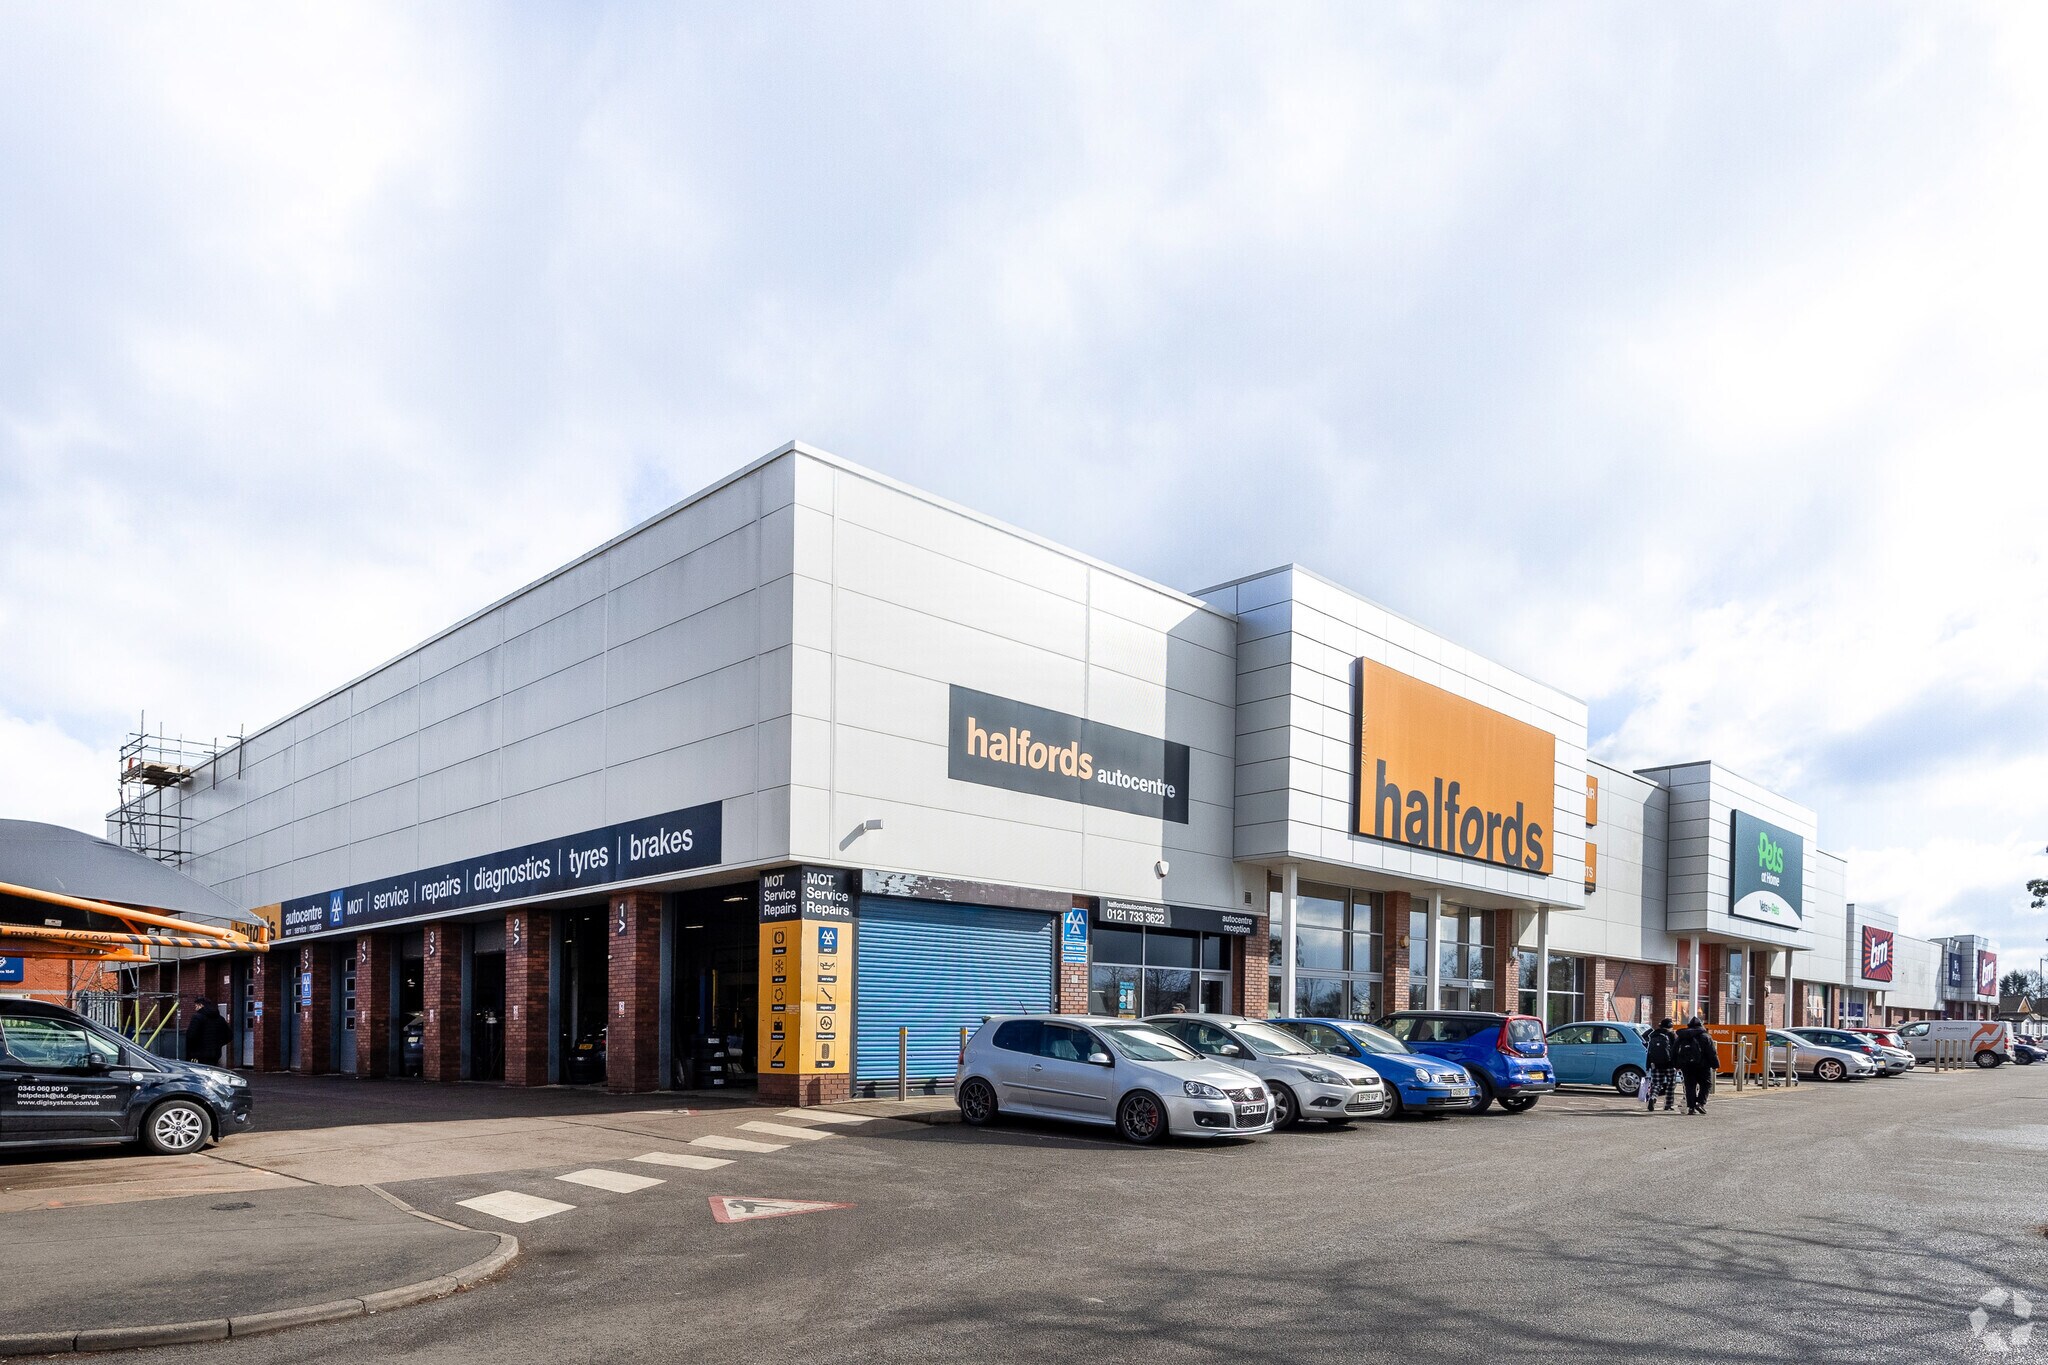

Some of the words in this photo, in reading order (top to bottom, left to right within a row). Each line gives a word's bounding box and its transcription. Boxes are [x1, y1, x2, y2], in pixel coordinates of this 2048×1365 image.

[967, 716, 1093, 780] halfords
[1097, 768, 1176, 798] autocentre
[1374, 758, 1544, 871] halfords
[1758, 831, 1784, 873] Pets
[347, 898, 363, 915] MOT
[373, 885, 409, 910] service
[421, 874, 461, 904] repairs
[474, 856, 551, 893] diagnostics
[569, 846, 608, 878] tyres
[630, 827, 693, 861] brakes
[764, 874, 785, 888] MOT
[806, 872, 834, 886] MOT
[1761, 872, 1767, 883] at
[1767, 872, 1780, 887] Home
[764, 888, 796, 902] Service
[806, 887, 849, 902] Service
[619, 903, 625, 917] 1
[764, 902, 797, 917] Repairs
[806, 901, 850, 916] Repairs
[1107, 901, 1164, 914] halfordsautocentres.com
[285, 905, 323, 926] autocentre
[1107, 908, 1127, 921] 0121
[1129, 911, 1144, 922] 733
[1145, 912, 1165, 925] 3622
[1222, 914, 1253, 926] autocentre
[294, 925, 307, 934] service
[309, 922, 322, 933] repairs
[514, 918, 520, 931] 2
[1223, 924, 1251, 934] reception
[429, 931, 435, 942] 3
[361, 941, 366, 951] 4
[256, 956, 261, 965] 6
[305, 949, 309, 959] 5
[17, 1092, 117, 1100] helpdesk@uk.digi-group.com
